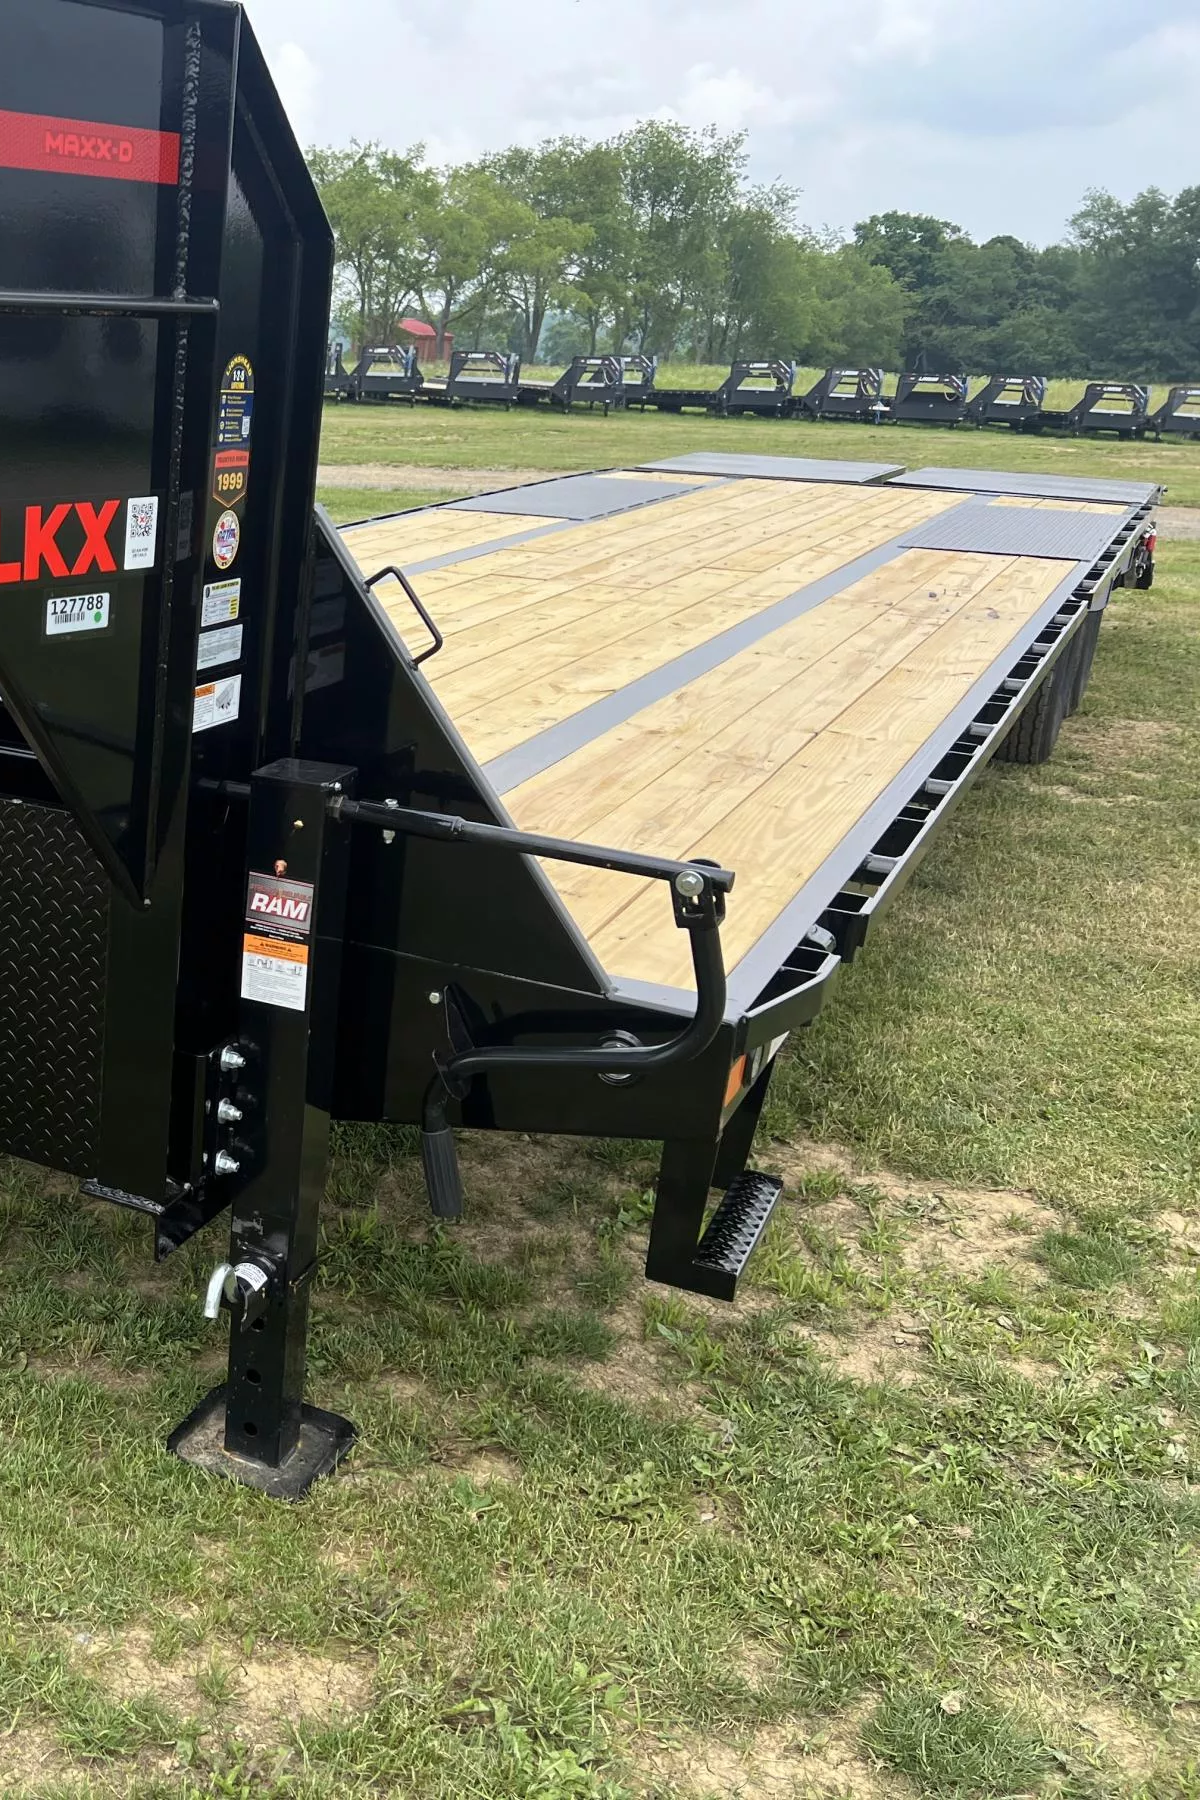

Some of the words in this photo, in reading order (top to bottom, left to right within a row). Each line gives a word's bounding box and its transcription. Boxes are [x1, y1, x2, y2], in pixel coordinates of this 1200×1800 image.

[44, 129, 134, 164] MAXX-D
[217, 472, 243, 491] 1999
[50, 595, 104, 616] 127788
[250, 892, 309, 921] RAM
